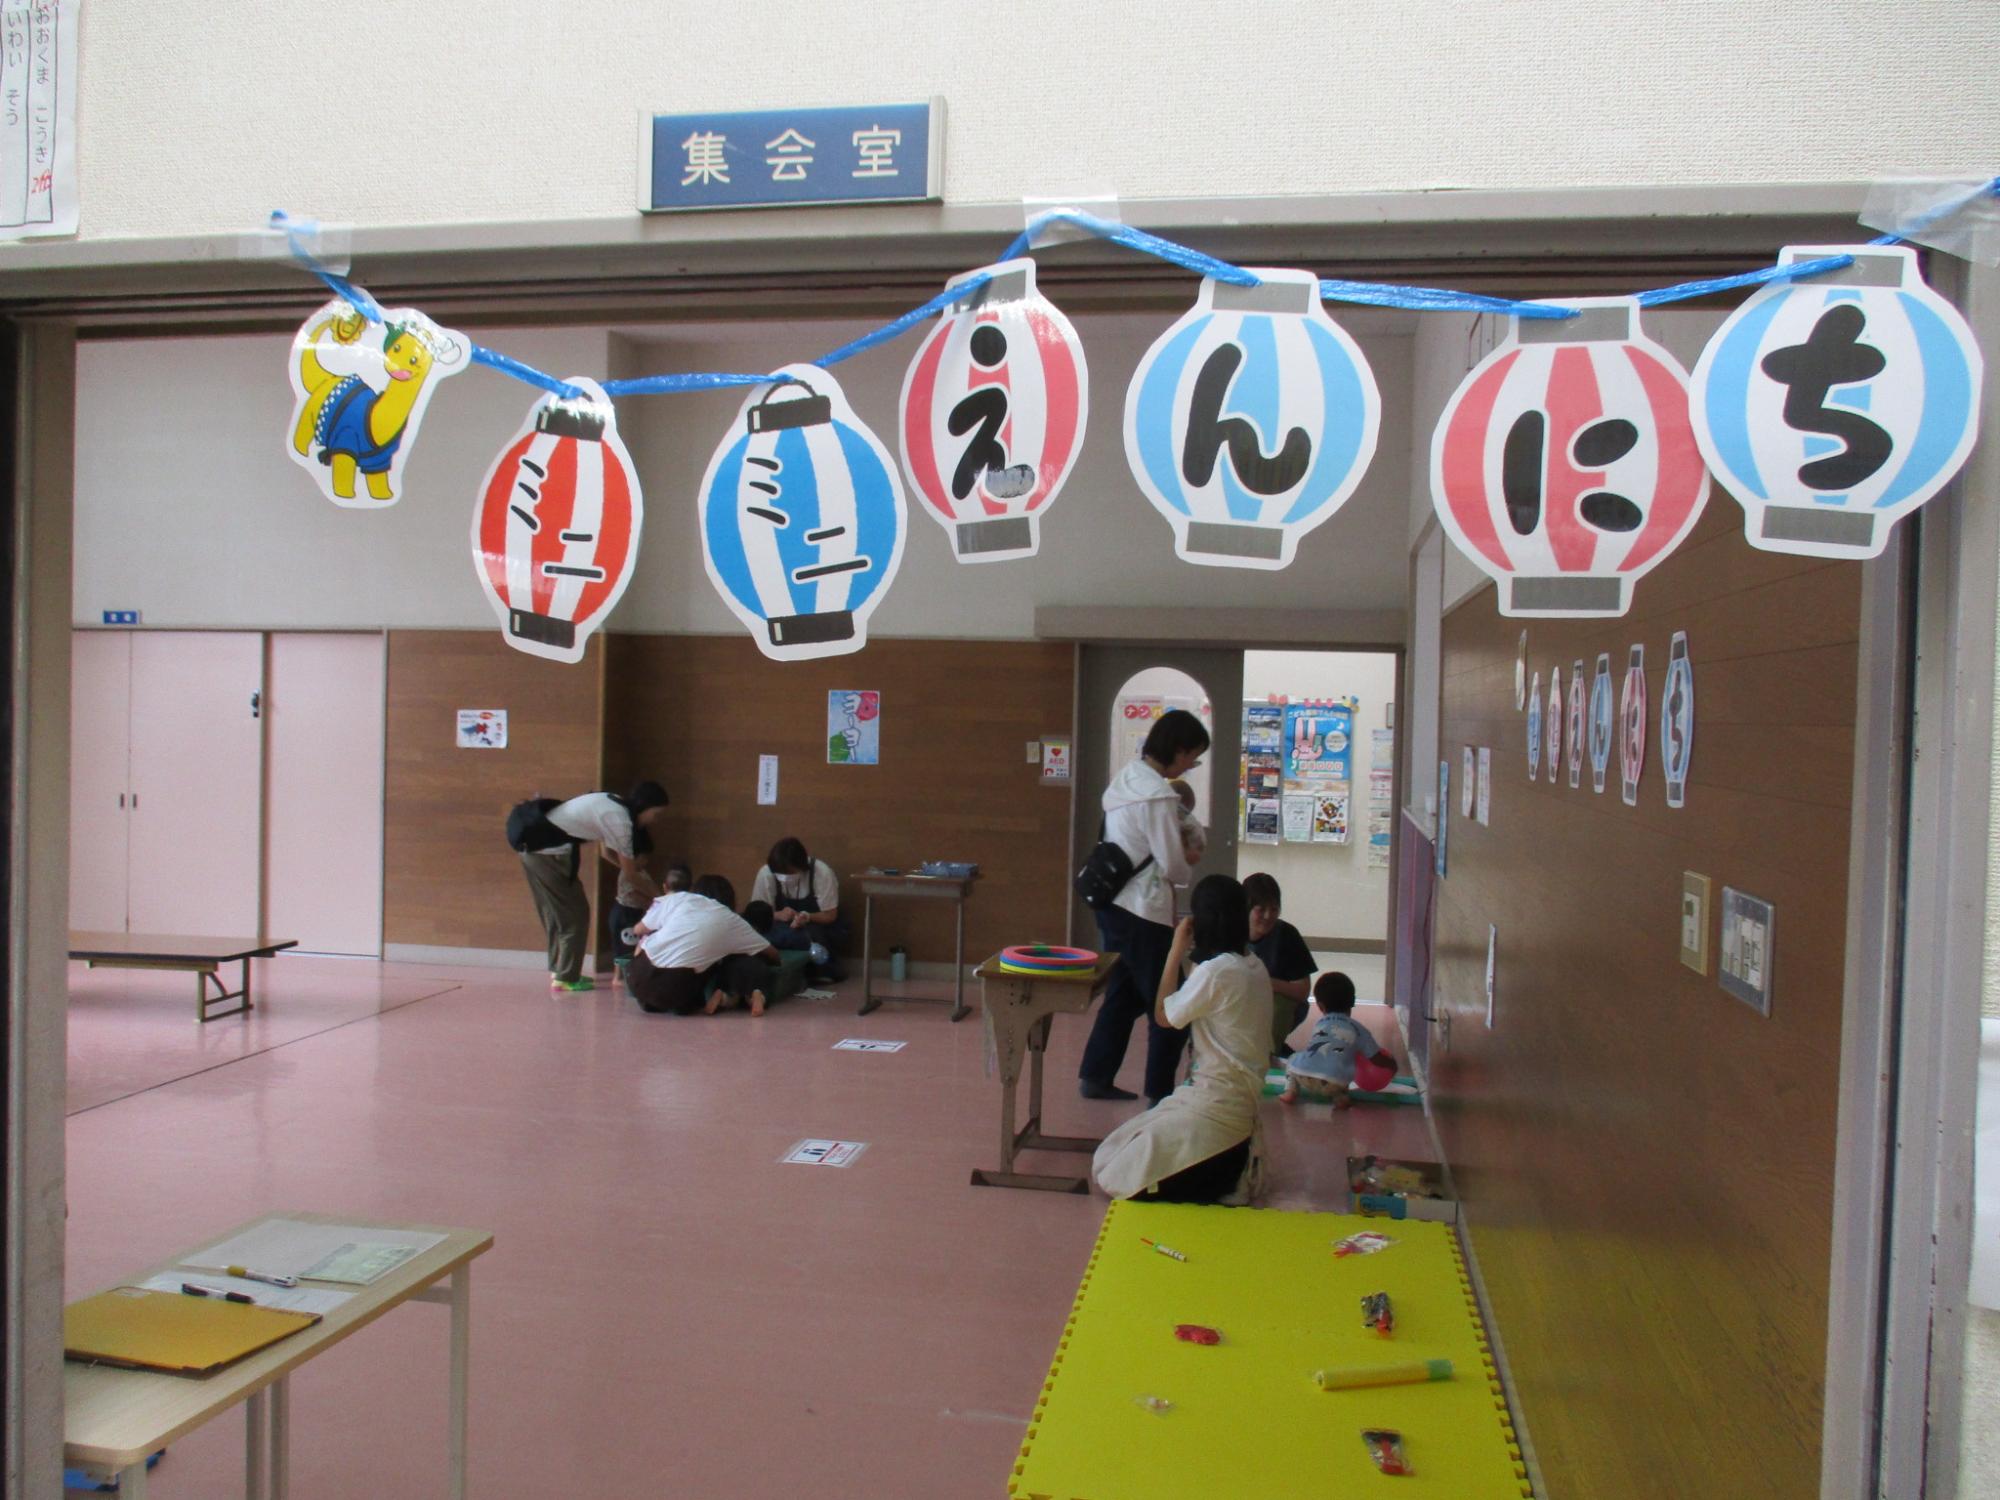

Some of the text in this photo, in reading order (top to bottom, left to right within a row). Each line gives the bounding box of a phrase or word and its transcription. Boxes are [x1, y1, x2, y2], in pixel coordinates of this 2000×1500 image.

[680, 124, 903, 187] 集会室
[947, 325, 1037, 500] え
[1183, 342, 1312, 495] ん
[1502, 409, 1643, 535] に
[1761, 303, 1894, 491] ち
